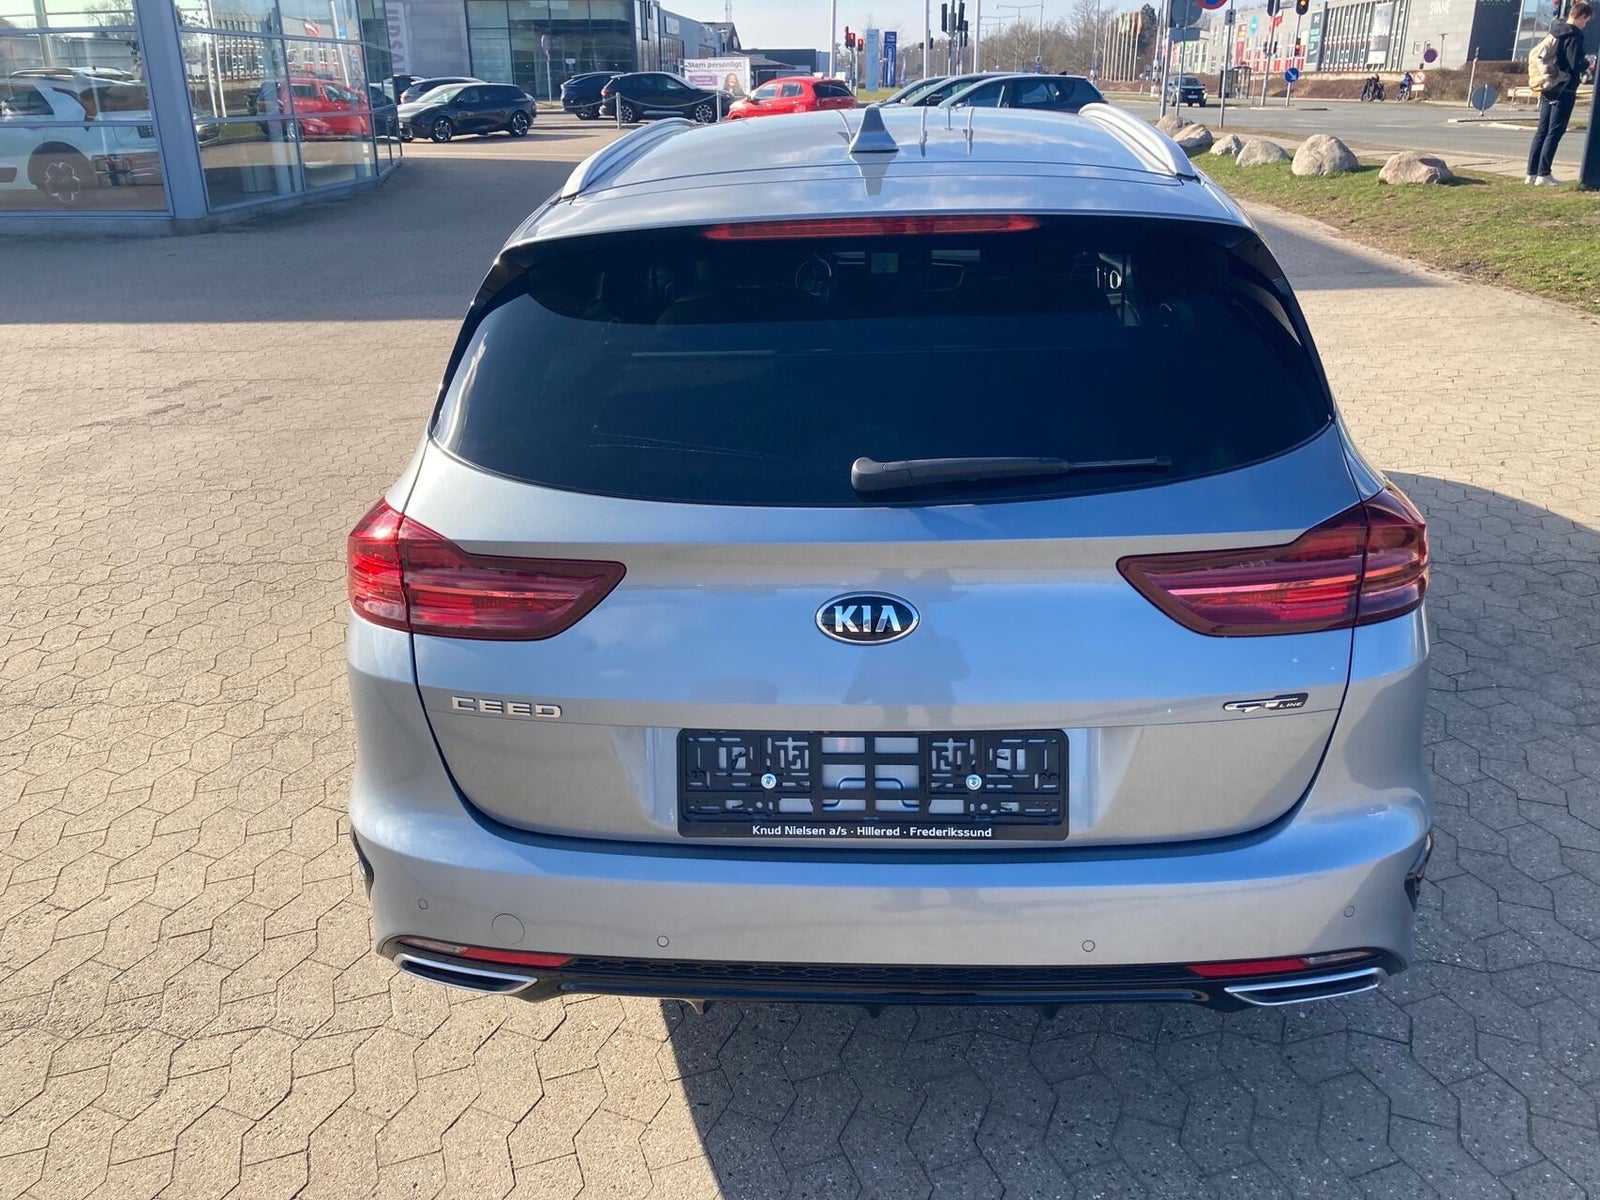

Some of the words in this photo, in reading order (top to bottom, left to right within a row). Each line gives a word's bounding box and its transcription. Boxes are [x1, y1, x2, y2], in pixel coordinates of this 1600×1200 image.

[708, 61, 742, 69] personligt
[834, 605, 902, 632] KIA
[451, 696, 563, 718] CEED
[752, 825, 782, 835] Knud
[784, 825, 826, 836] Nielsen
[829, 826, 847, 836] a/s
[857, 826, 900, 836] Hillerød
[909, 826, 993, 837] Frederikssund
